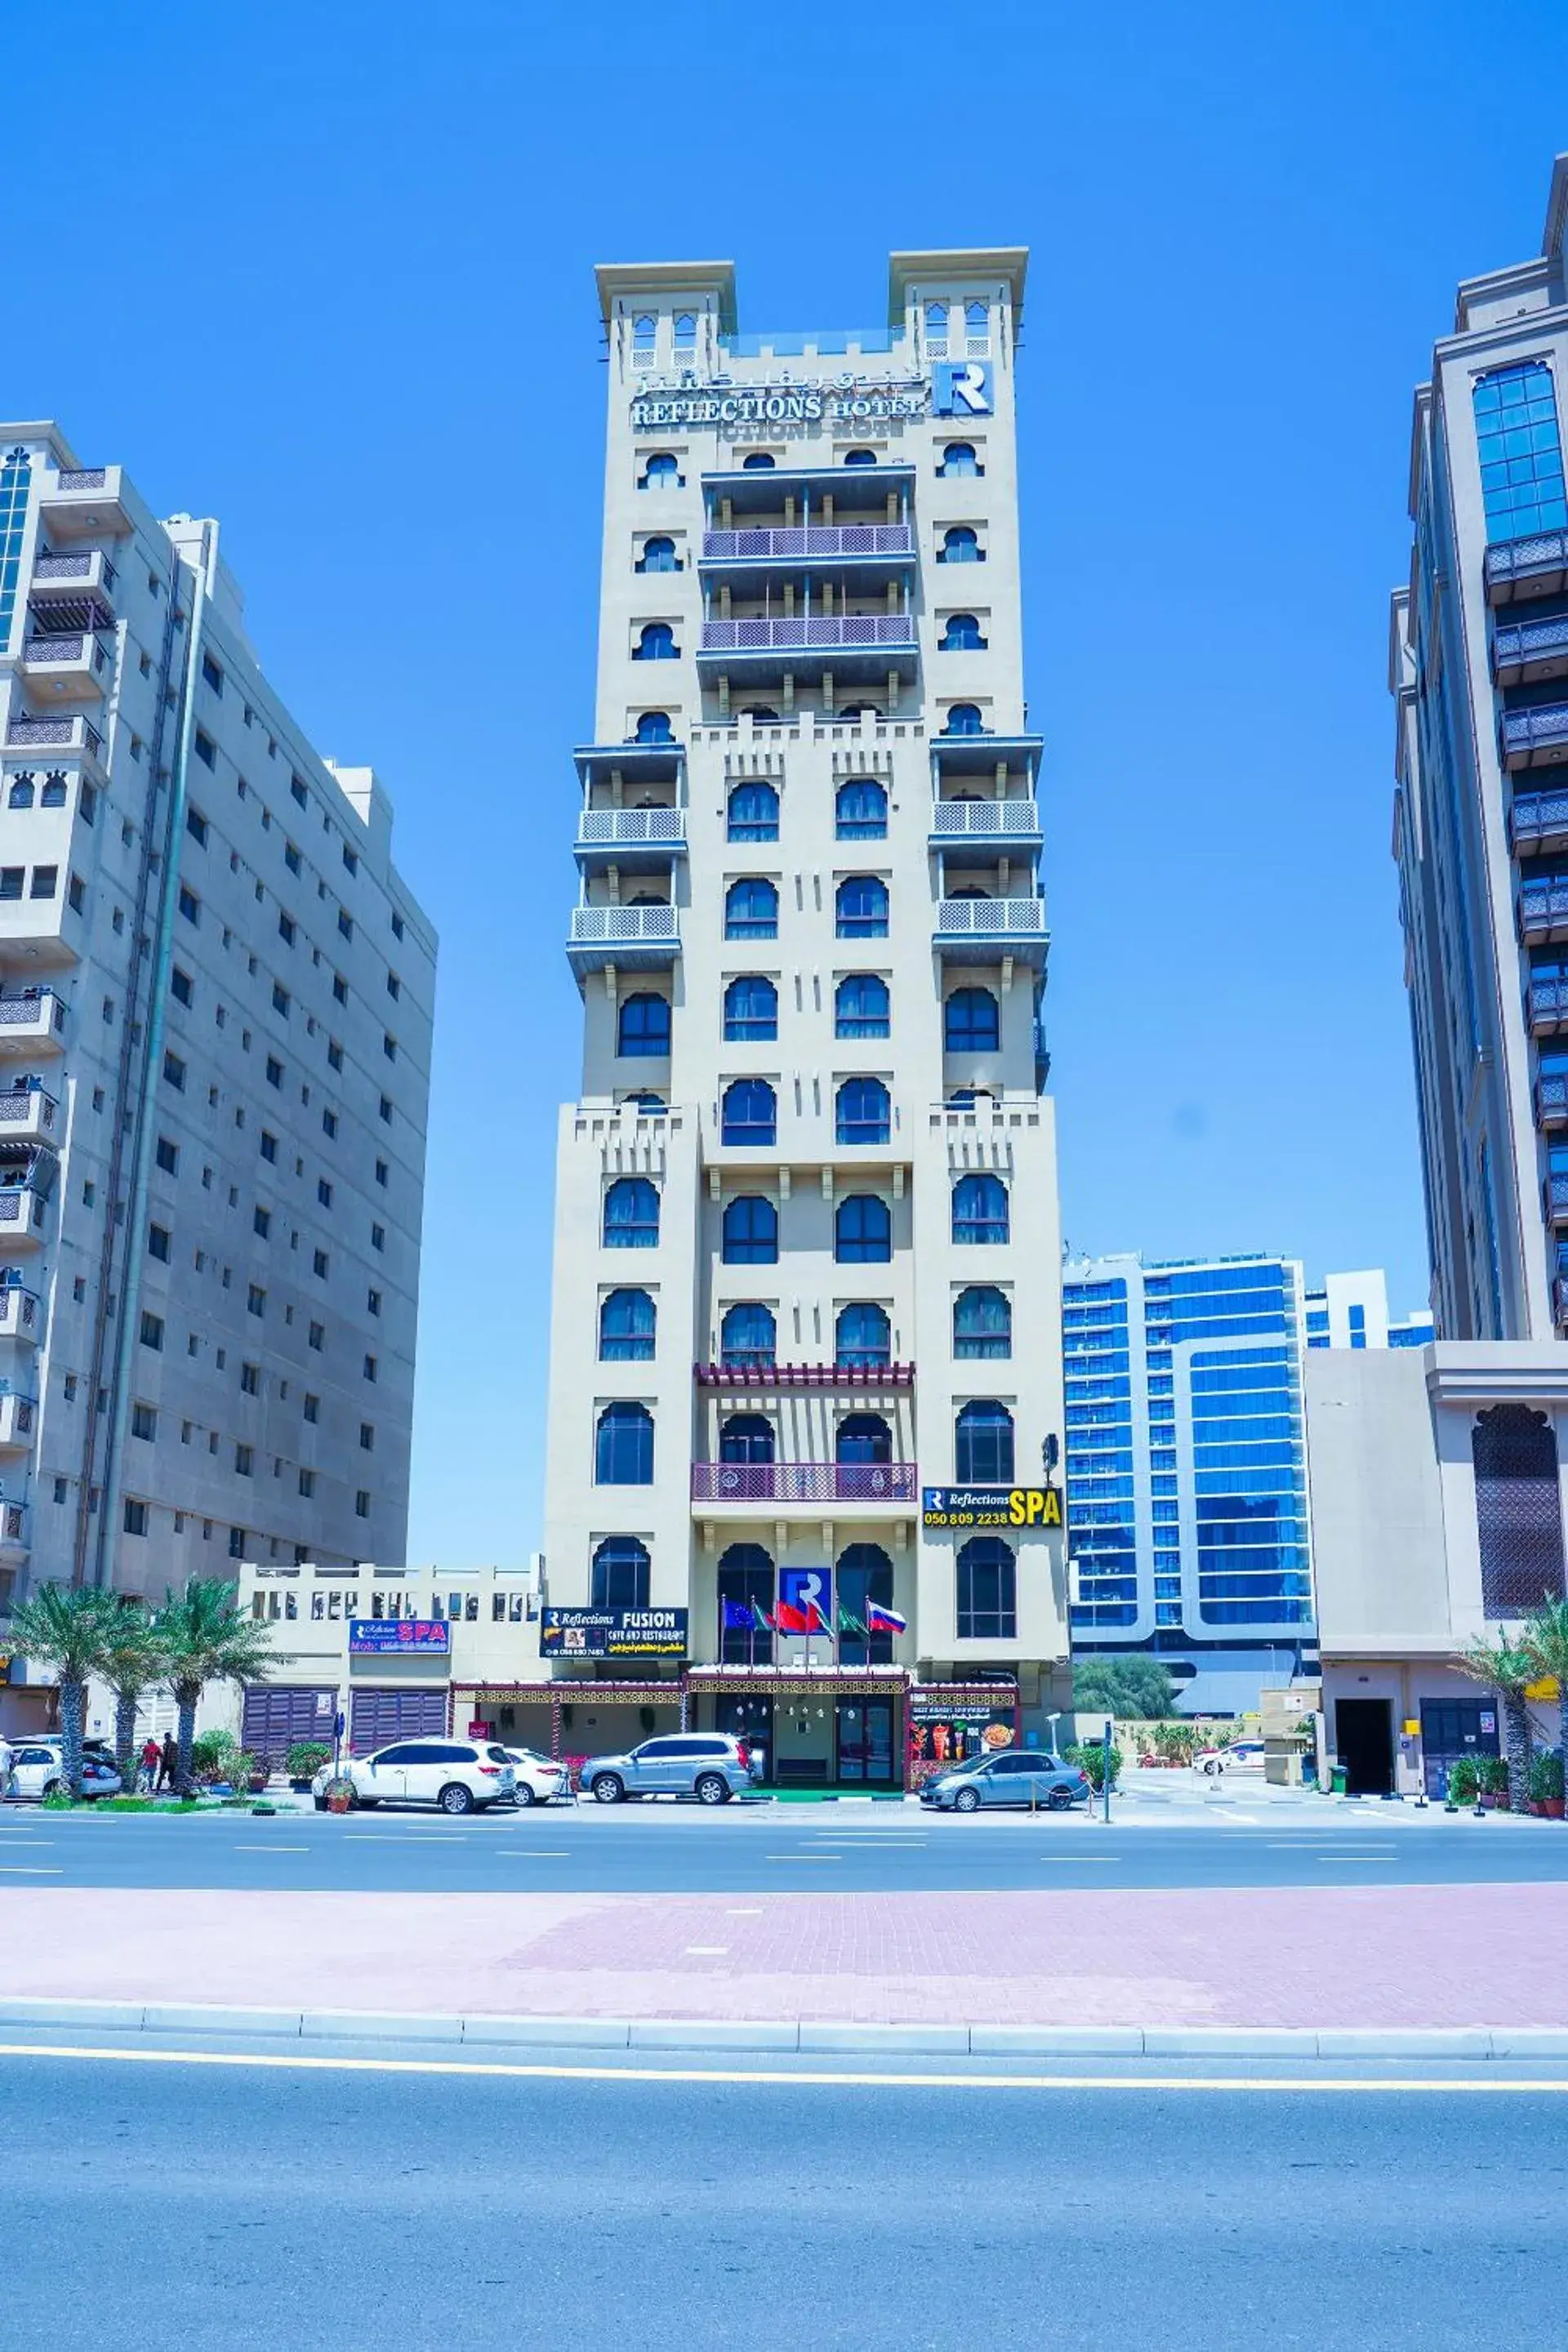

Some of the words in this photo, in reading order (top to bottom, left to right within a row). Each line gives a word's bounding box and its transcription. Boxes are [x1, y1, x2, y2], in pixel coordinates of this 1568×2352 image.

[938, 363, 990, 412] R
[633, 395, 822, 425] REFLECTIONS
[831, 398, 920, 418] HOTEL
[950, 1493, 1009, 1508] Reflections
[1009, 1490, 1061, 1526] SPA
[924, 1512, 947, 1525] 050
[949, 1512, 973, 1525] 809
[977, 1512, 1009, 1525] 2238
[622, 1611, 675, 1628] FUSION
[398, 1623, 447, 1641] SPA
